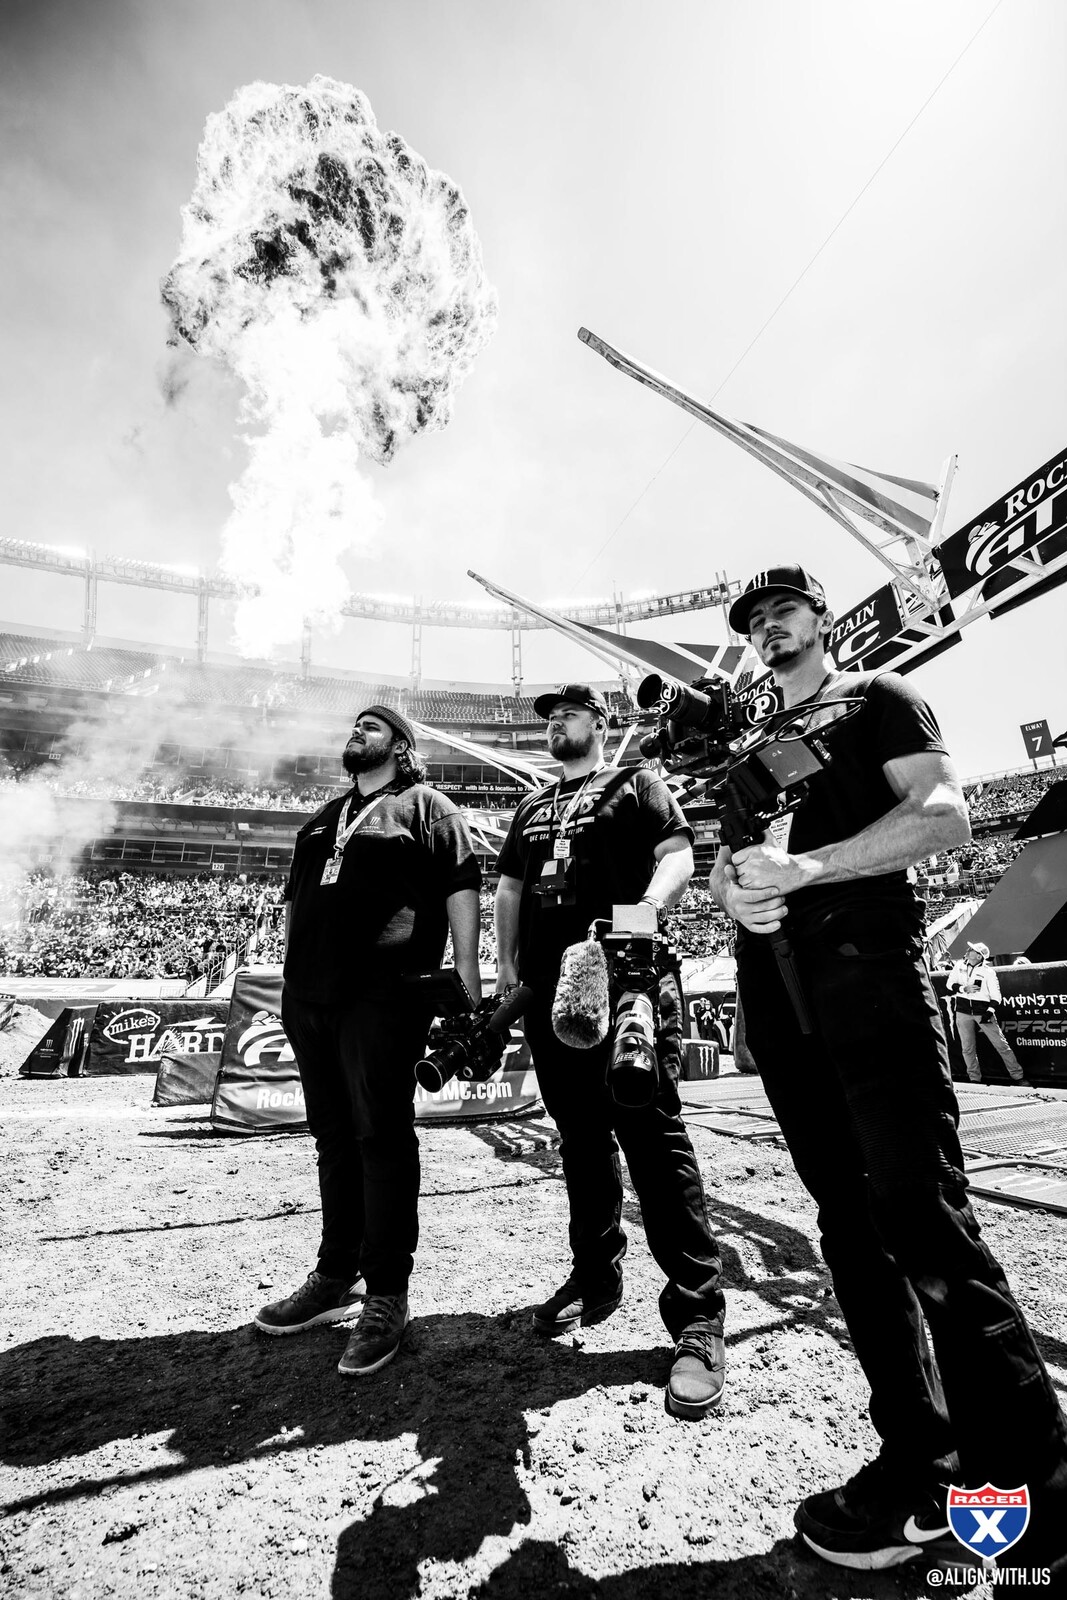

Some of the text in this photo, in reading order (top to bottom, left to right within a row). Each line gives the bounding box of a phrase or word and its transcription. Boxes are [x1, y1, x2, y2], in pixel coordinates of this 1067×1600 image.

[1004, 459, 1067, 522] ROC
[1025, 722, 1043, 731] ELWAY
[1032, 735, 1043, 752] 7
[110, 1016, 157, 1036] mike's
